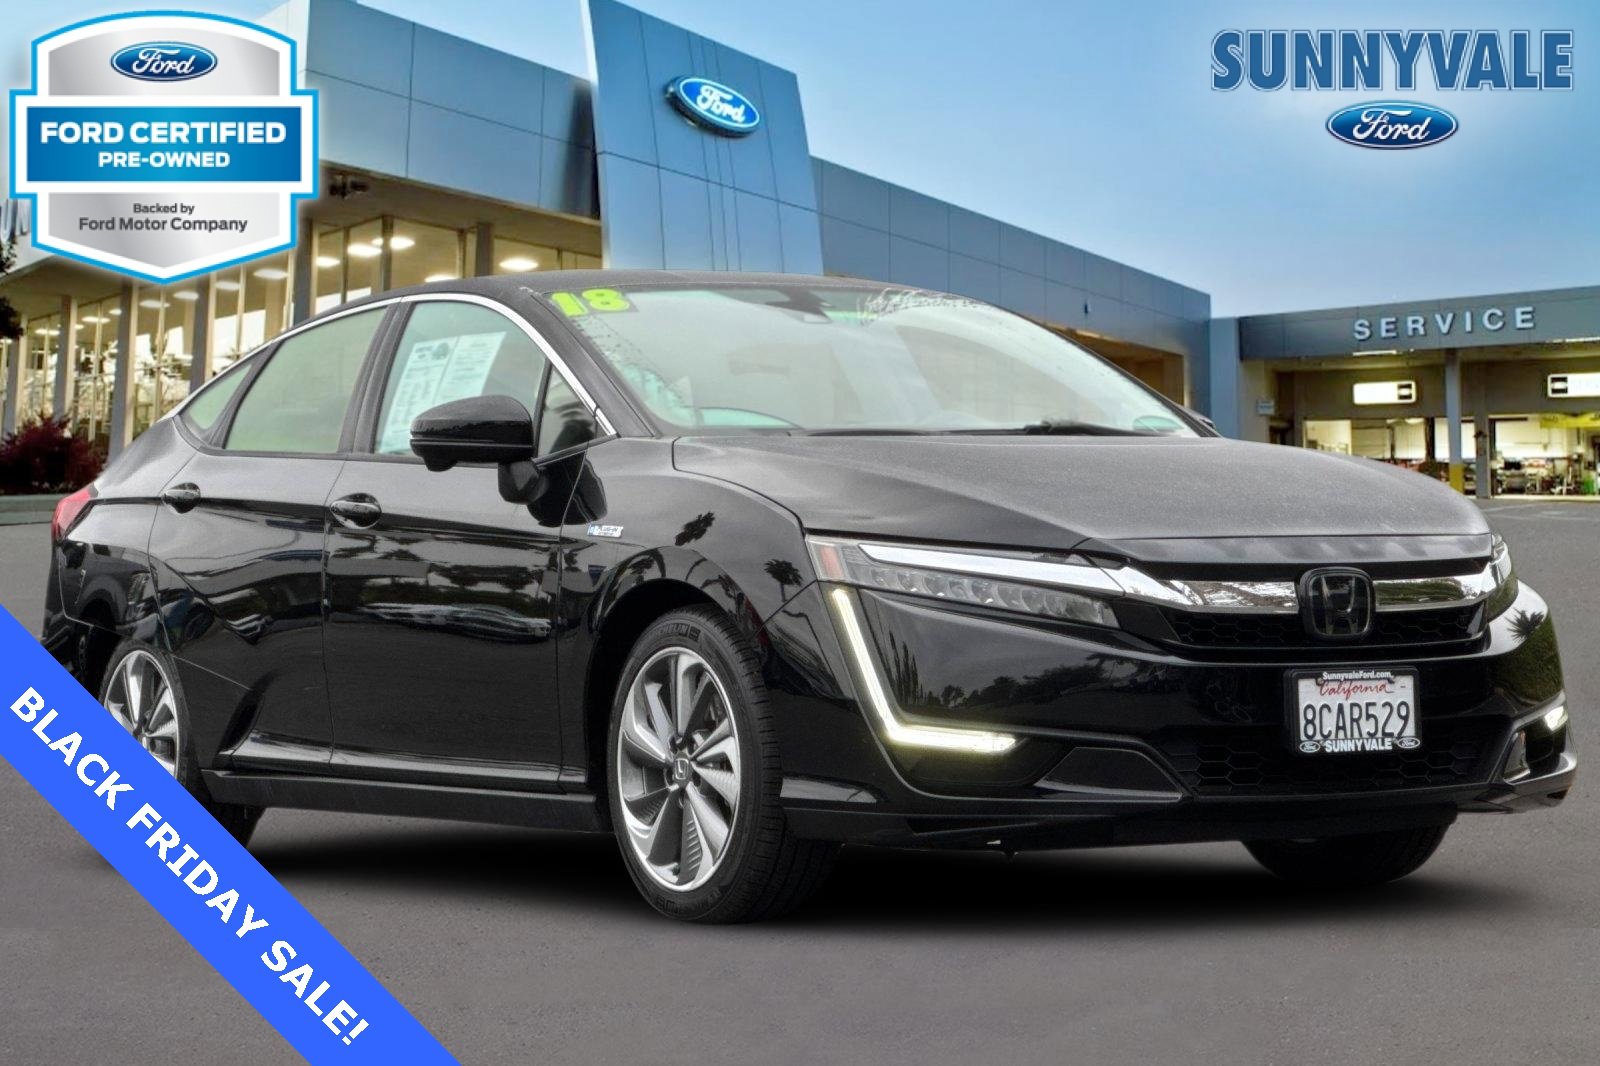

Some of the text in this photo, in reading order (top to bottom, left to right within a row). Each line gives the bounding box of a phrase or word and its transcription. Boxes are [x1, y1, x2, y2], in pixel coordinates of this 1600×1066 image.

[697, 85, 746, 122] Ford
[551, 288, 630, 317] 18
[1353, 306, 1535, 341] SERVICE
[1322, 670, 1392, 681] SunnyvaleFord.com
[1319, 680, 1395, 701] California
[1303, 700, 1411, 739] 8CAR529
[1325, 738, 1393, 753] SUNNYVALE
